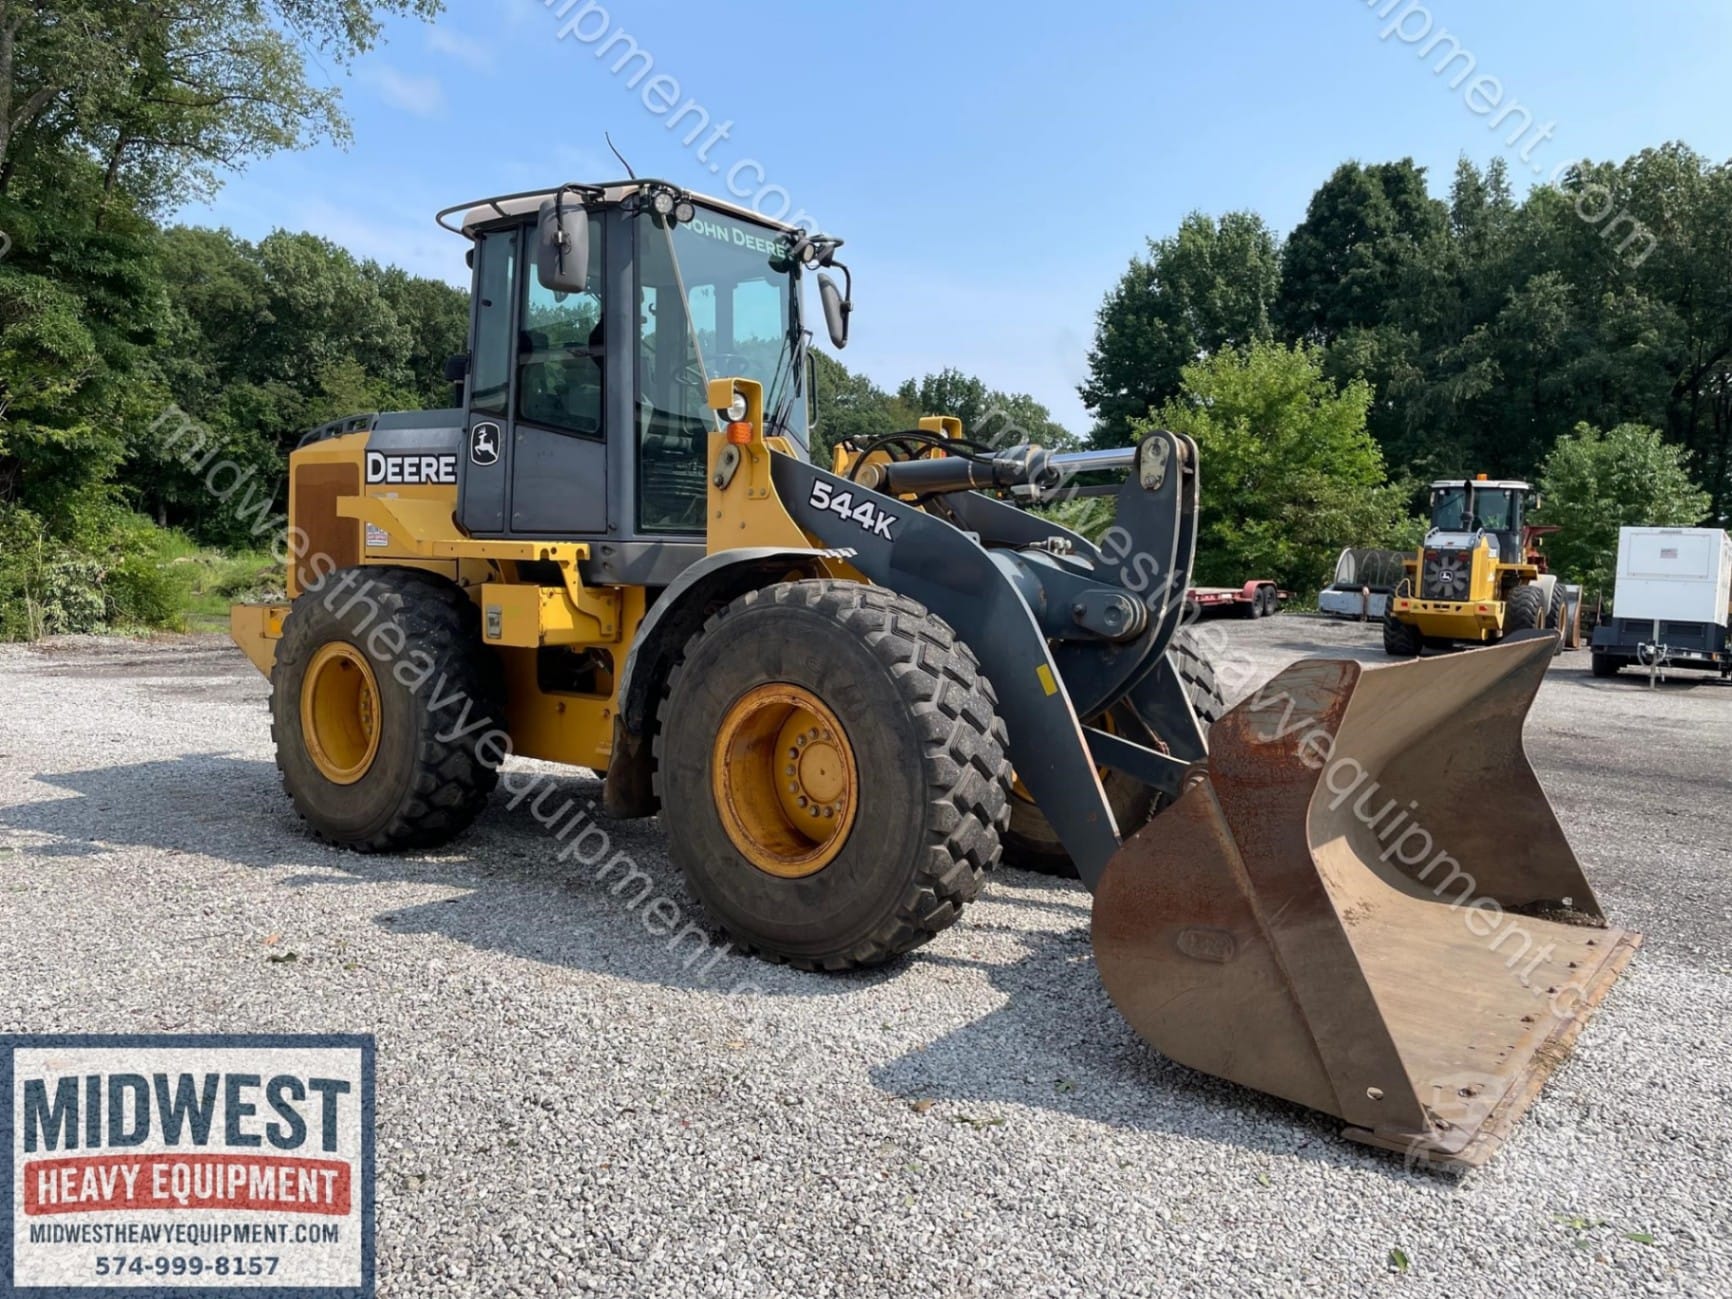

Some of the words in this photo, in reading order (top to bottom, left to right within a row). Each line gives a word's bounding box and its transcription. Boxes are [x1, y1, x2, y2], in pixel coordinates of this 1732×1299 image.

[681, 217, 730, 242] JOHN
[732, 226, 786, 259] DEERE
[366, 451, 457, 484] DEERE
[809, 479, 898, 541] 544K
